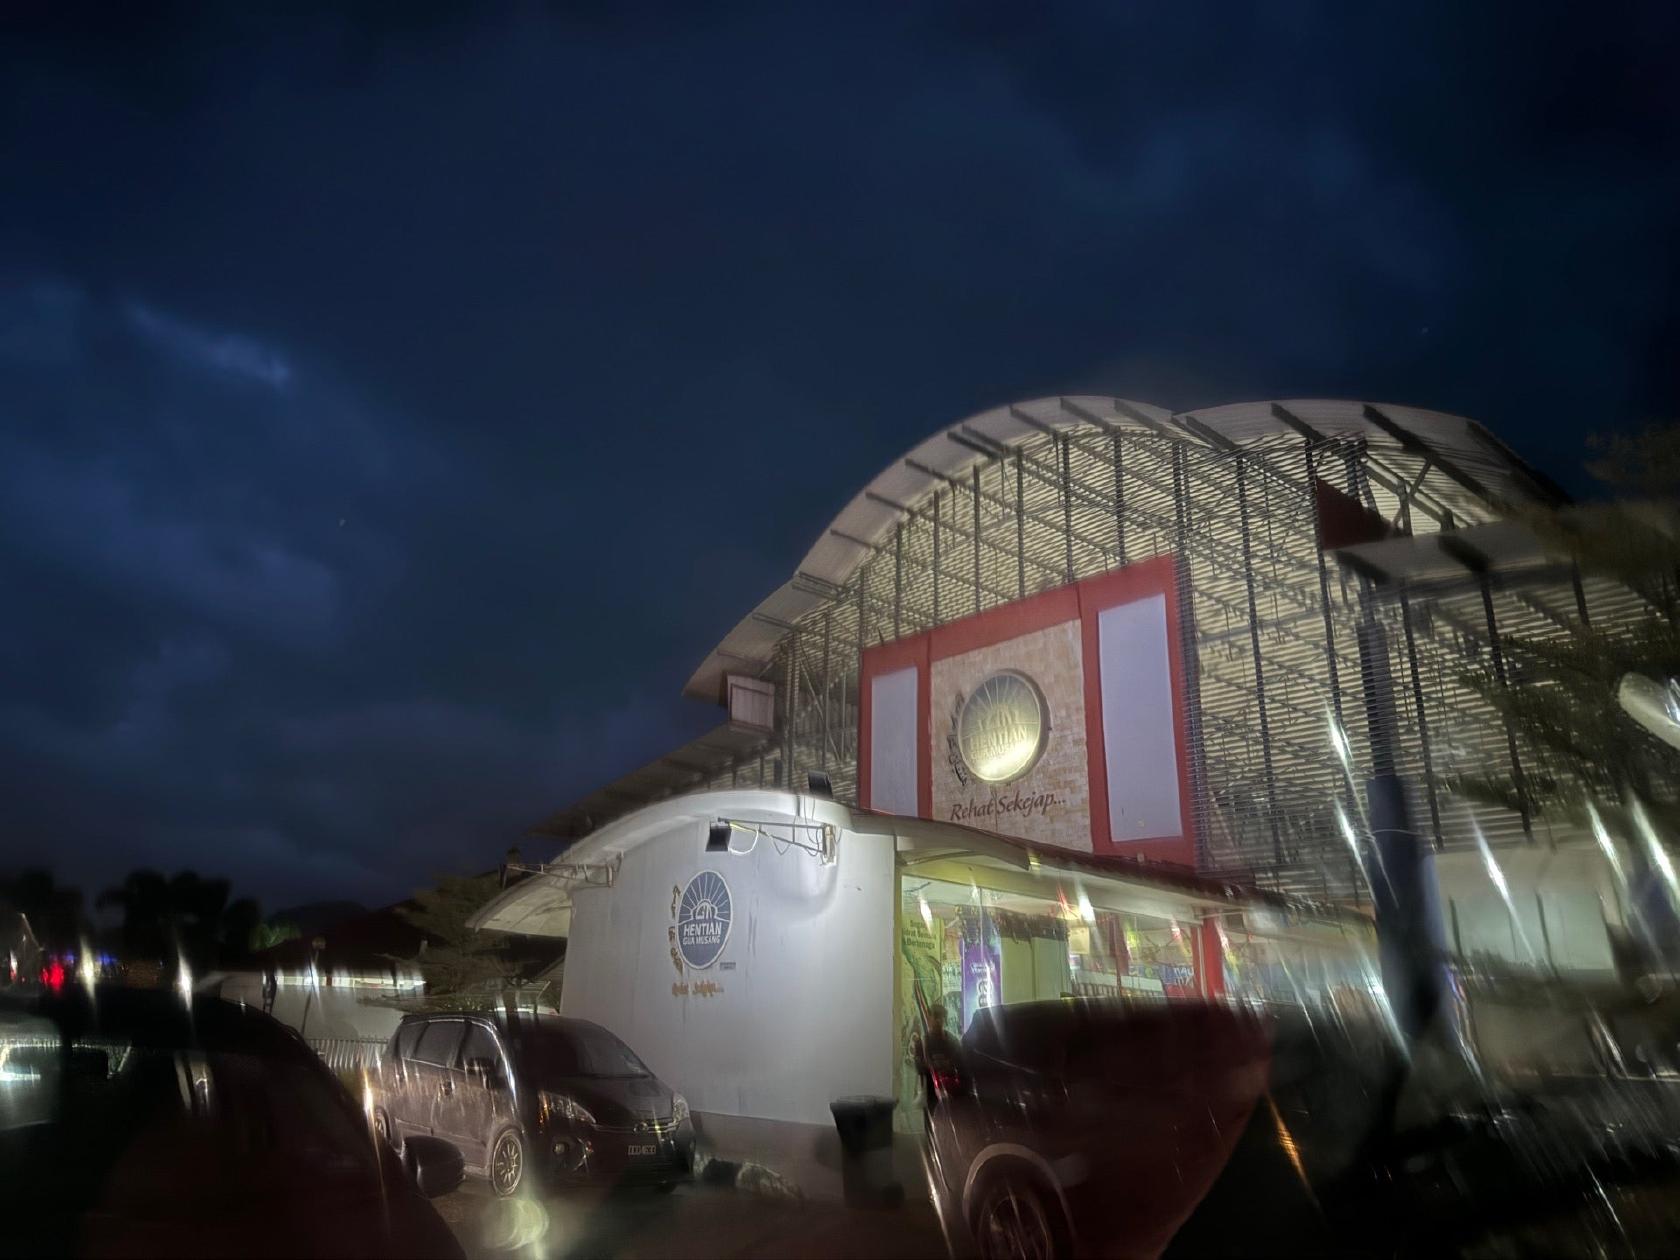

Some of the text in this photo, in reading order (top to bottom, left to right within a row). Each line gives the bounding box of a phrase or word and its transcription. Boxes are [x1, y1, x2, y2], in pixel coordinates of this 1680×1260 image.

[969, 725, 1028, 751] HENTIAN
[949, 798, 993, 821] Rehat
[683, 922, 722, 936] HENTIAN
